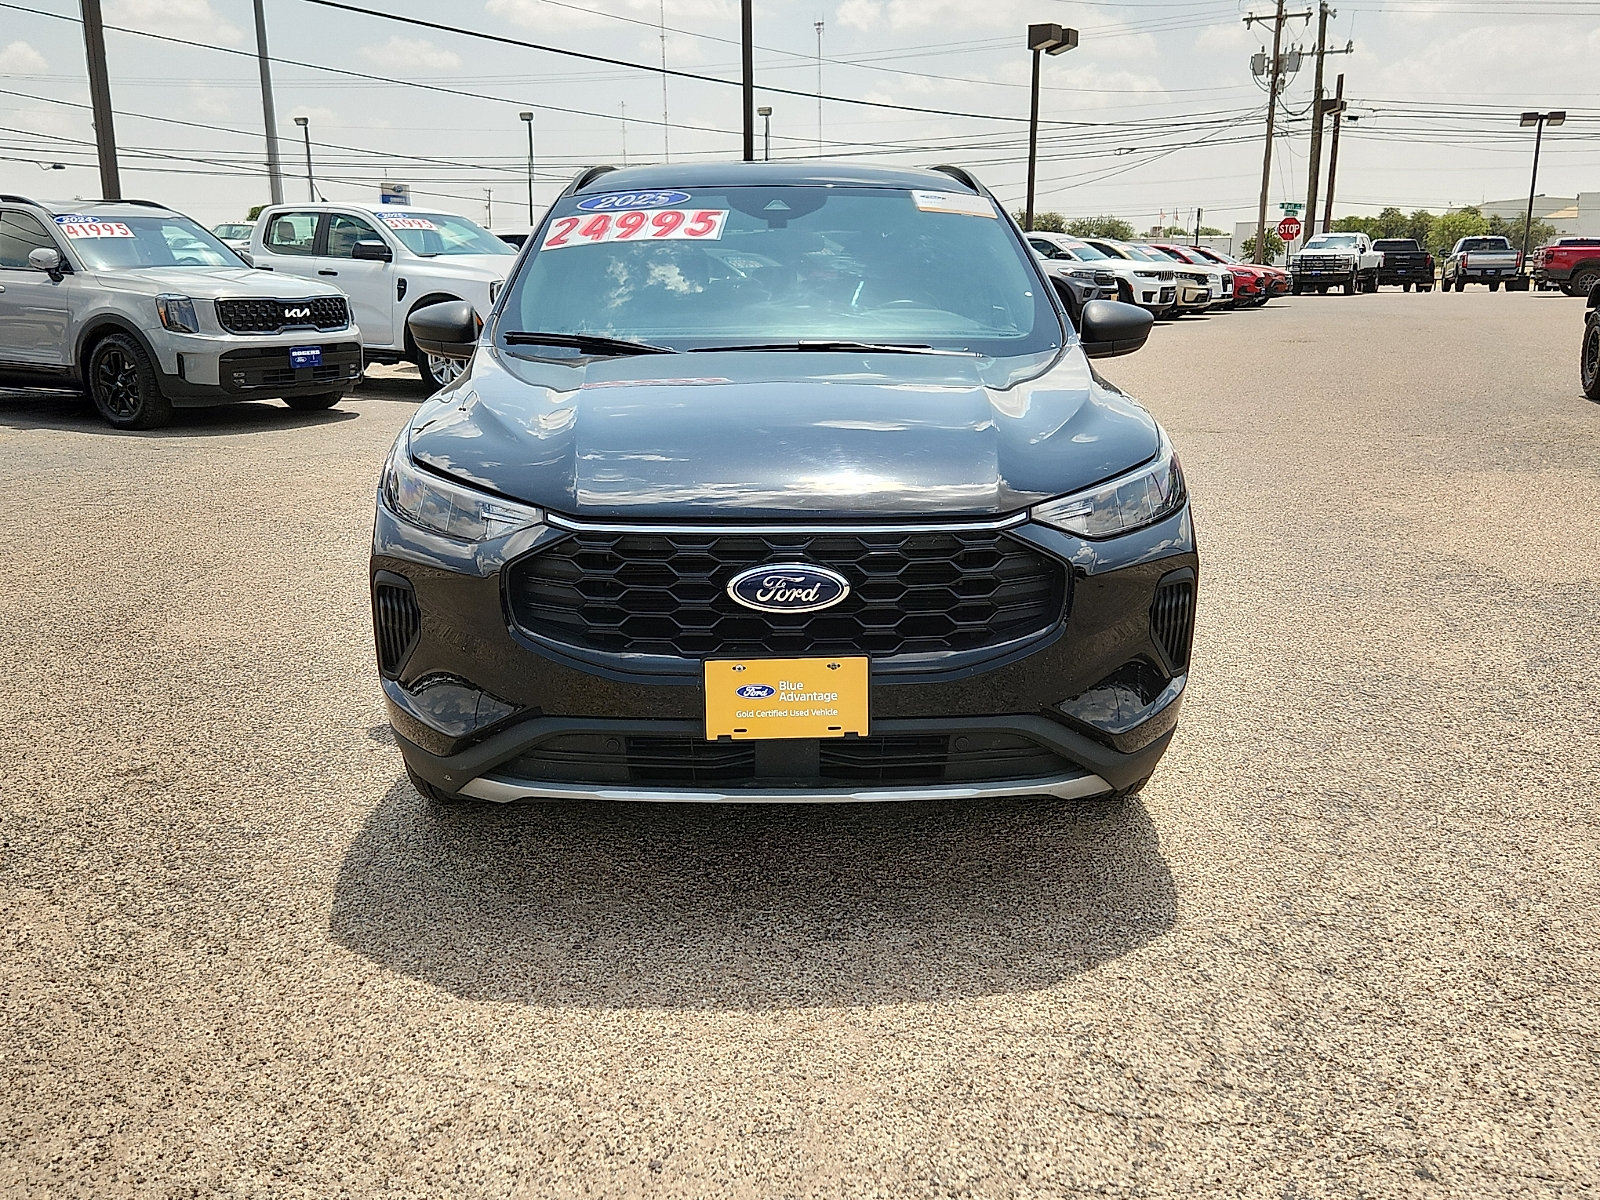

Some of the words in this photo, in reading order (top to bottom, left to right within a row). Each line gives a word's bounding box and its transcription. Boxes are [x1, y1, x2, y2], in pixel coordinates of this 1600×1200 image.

[593, 192, 675, 209] 2025
[386, 219, 433, 228] 31995
[545, 210, 723, 247] 24995
[1279, 224, 1300, 234] STOP
[66, 223, 129, 236] 41995
[756, 575, 821, 602] Ford
[778, 680, 804, 691] Blue
[742, 686, 768, 697] Ford
[778, 692, 838, 703] Advantage
[736, 710, 754, 718] Gold
[755, 709, 788, 717] Certified
[790, 709, 809, 717] Used
[810, 708, 838, 716] Vehicle
